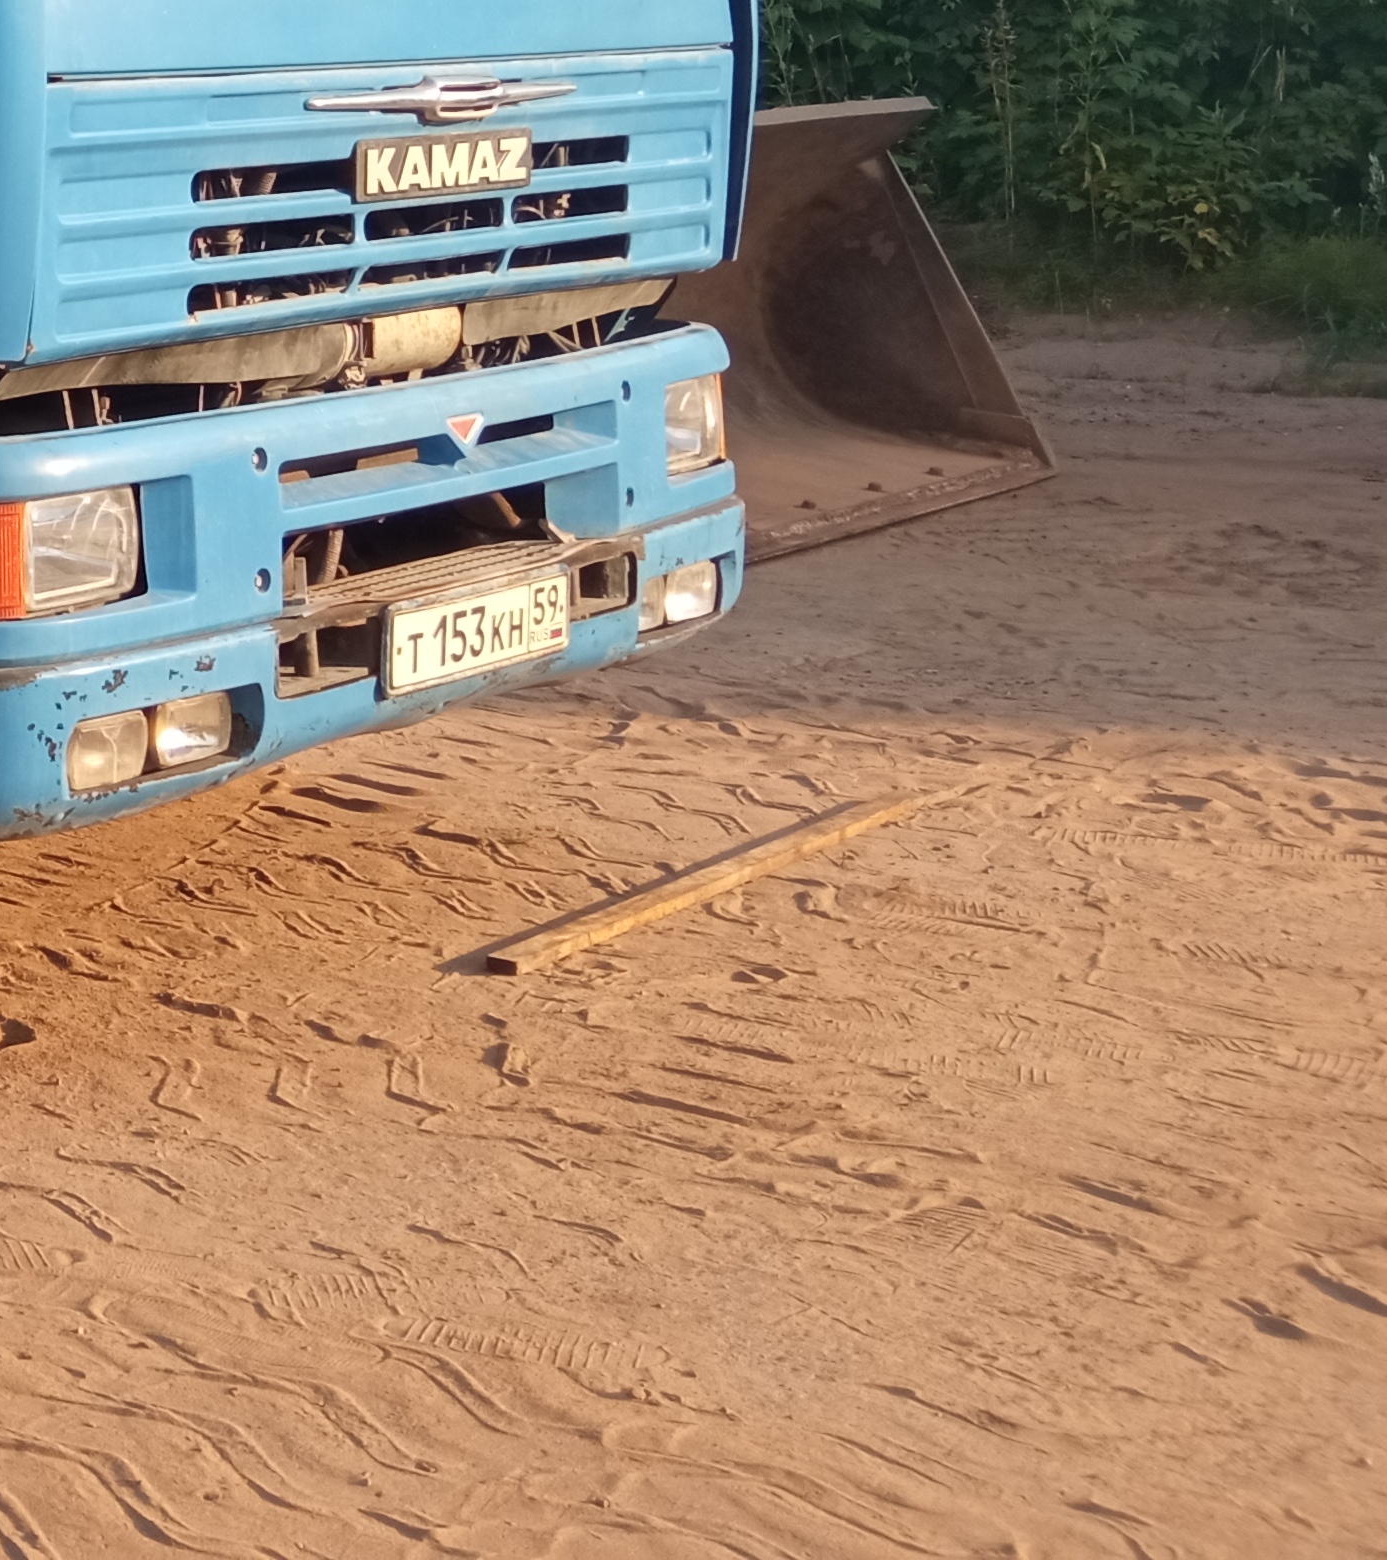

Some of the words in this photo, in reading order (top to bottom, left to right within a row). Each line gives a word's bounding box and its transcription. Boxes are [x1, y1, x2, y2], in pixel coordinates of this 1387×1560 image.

[365, 136, 528, 195] KAMAZ
[533, 585, 559, 626] 59
[529, 628, 549, 643] RUS
